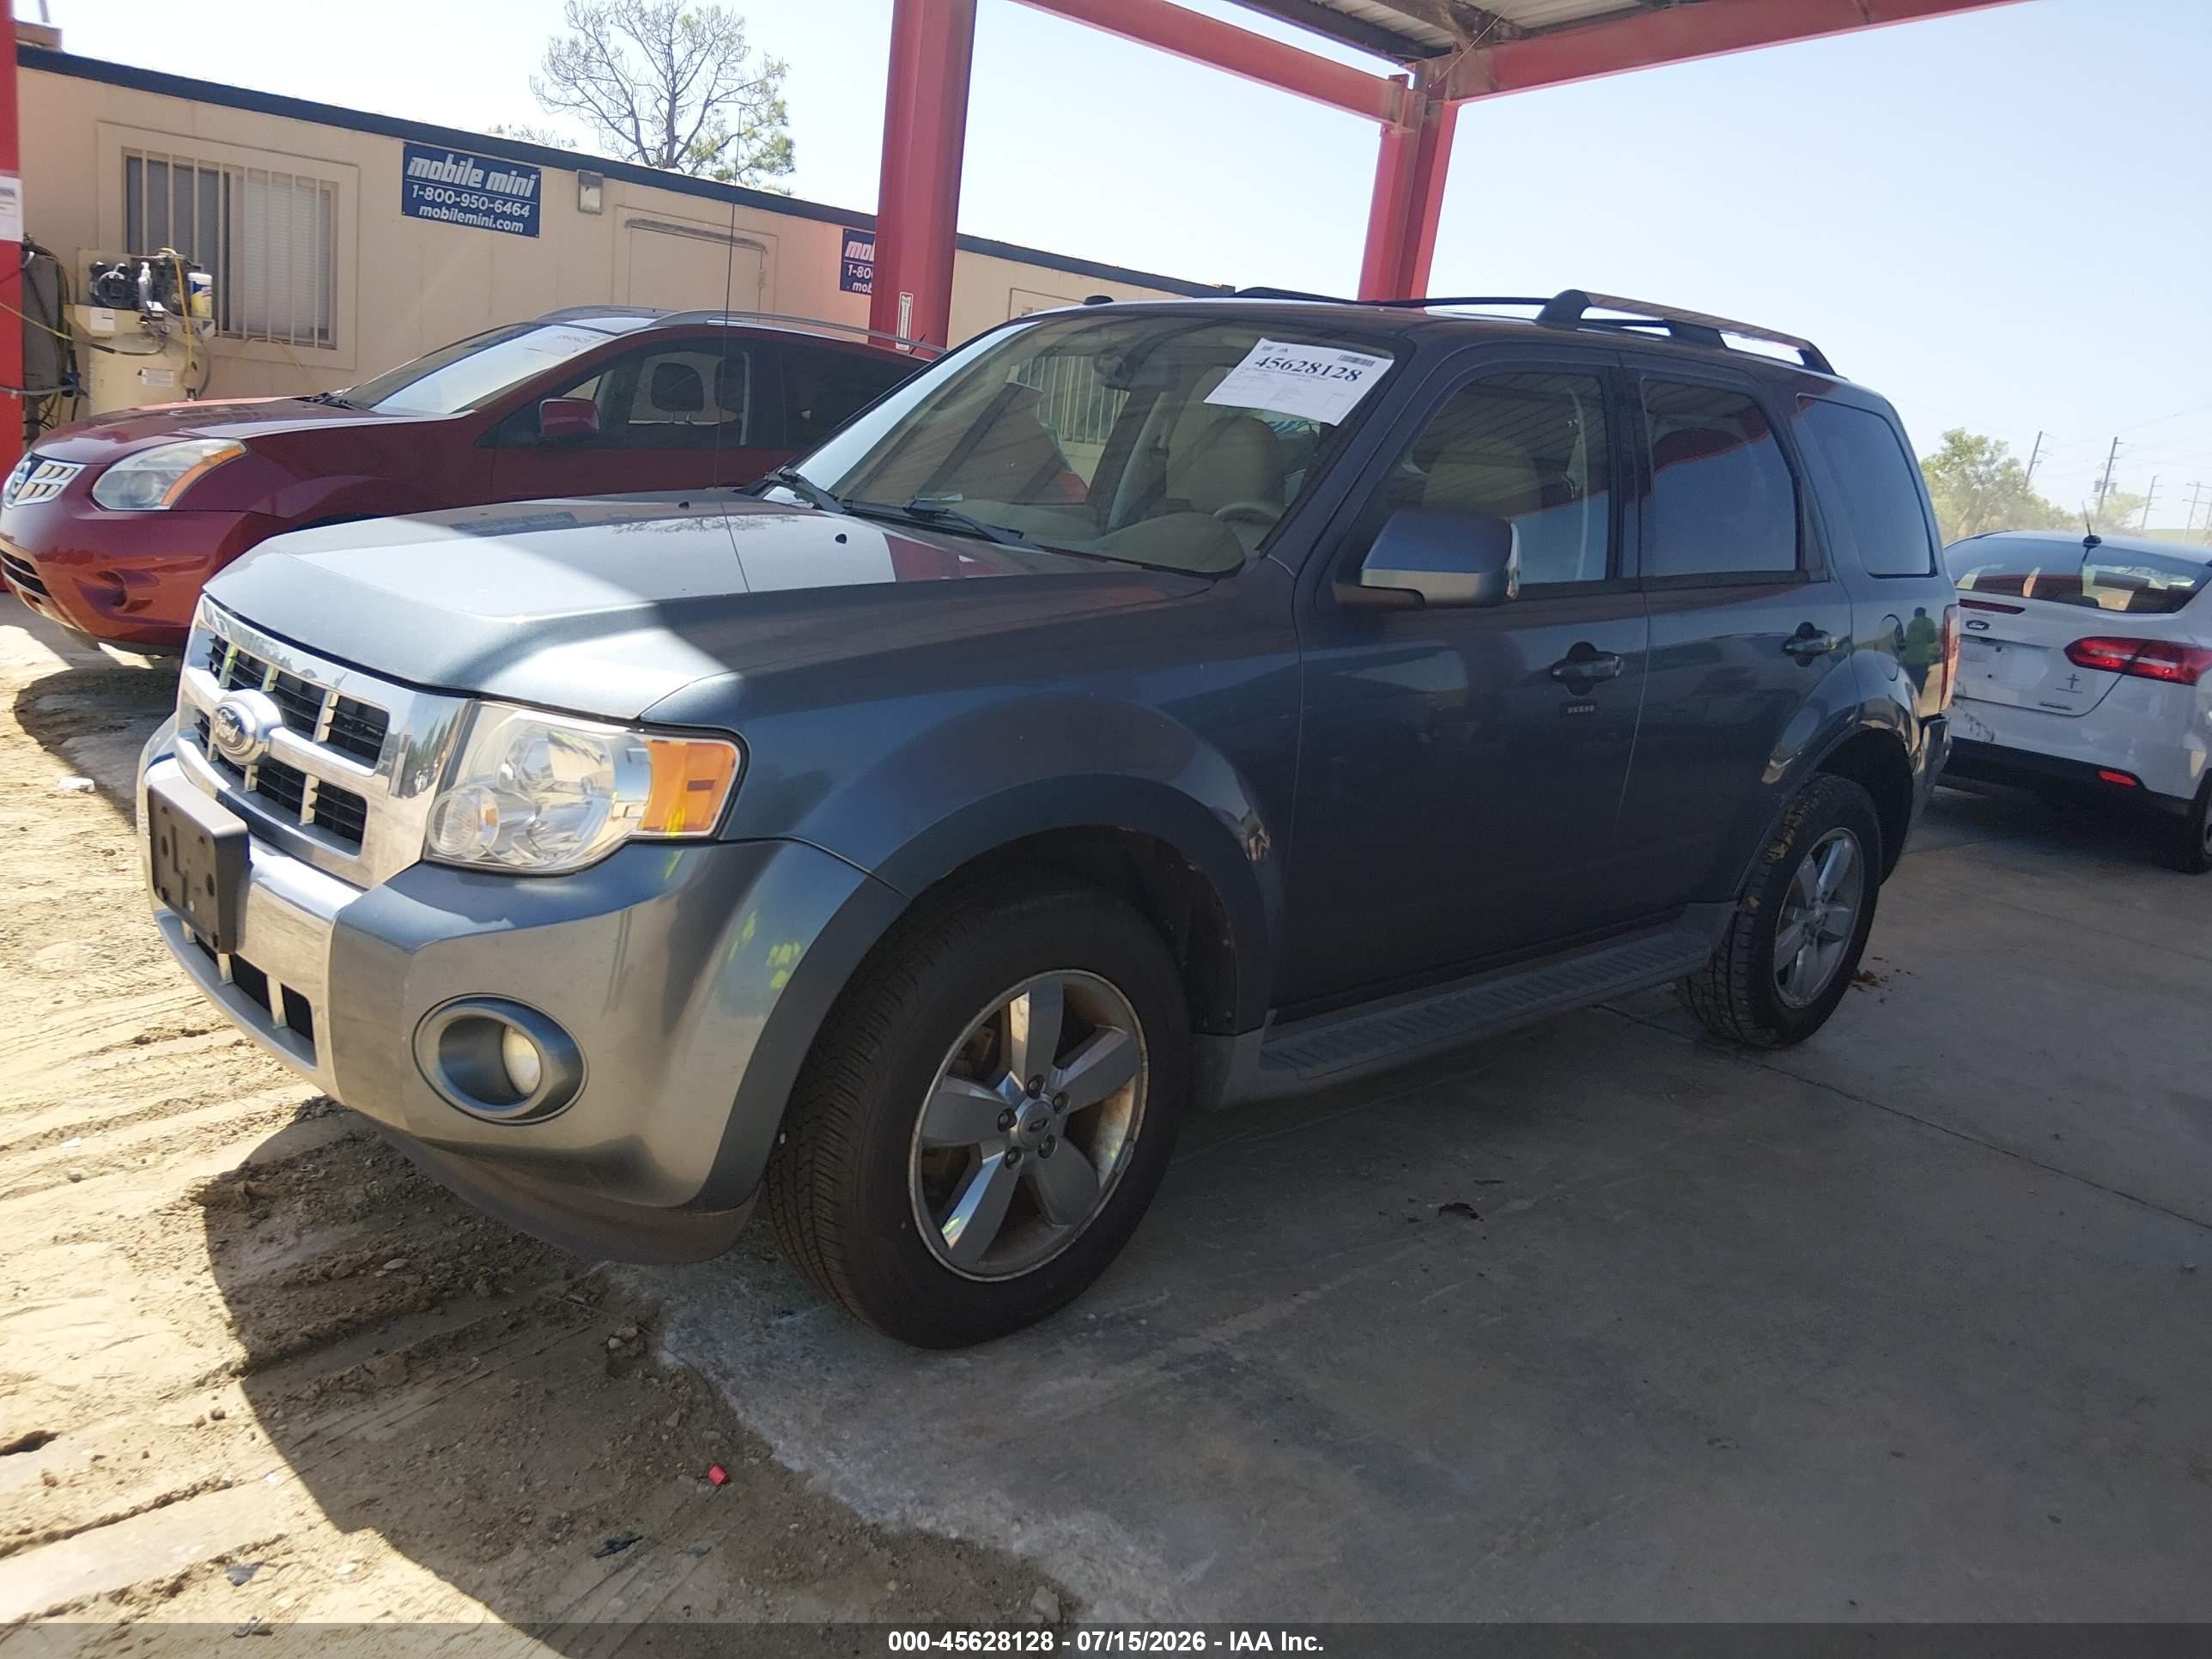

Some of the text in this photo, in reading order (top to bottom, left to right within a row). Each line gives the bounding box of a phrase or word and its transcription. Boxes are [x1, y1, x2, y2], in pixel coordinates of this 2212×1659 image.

[407, 154, 537, 198] mobile mini
[412, 185, 530, 218] 1-800-950-6464
[419, 205, 524, 233] mobilemini.com
[1255, 356, 1363, 382] 45628128
